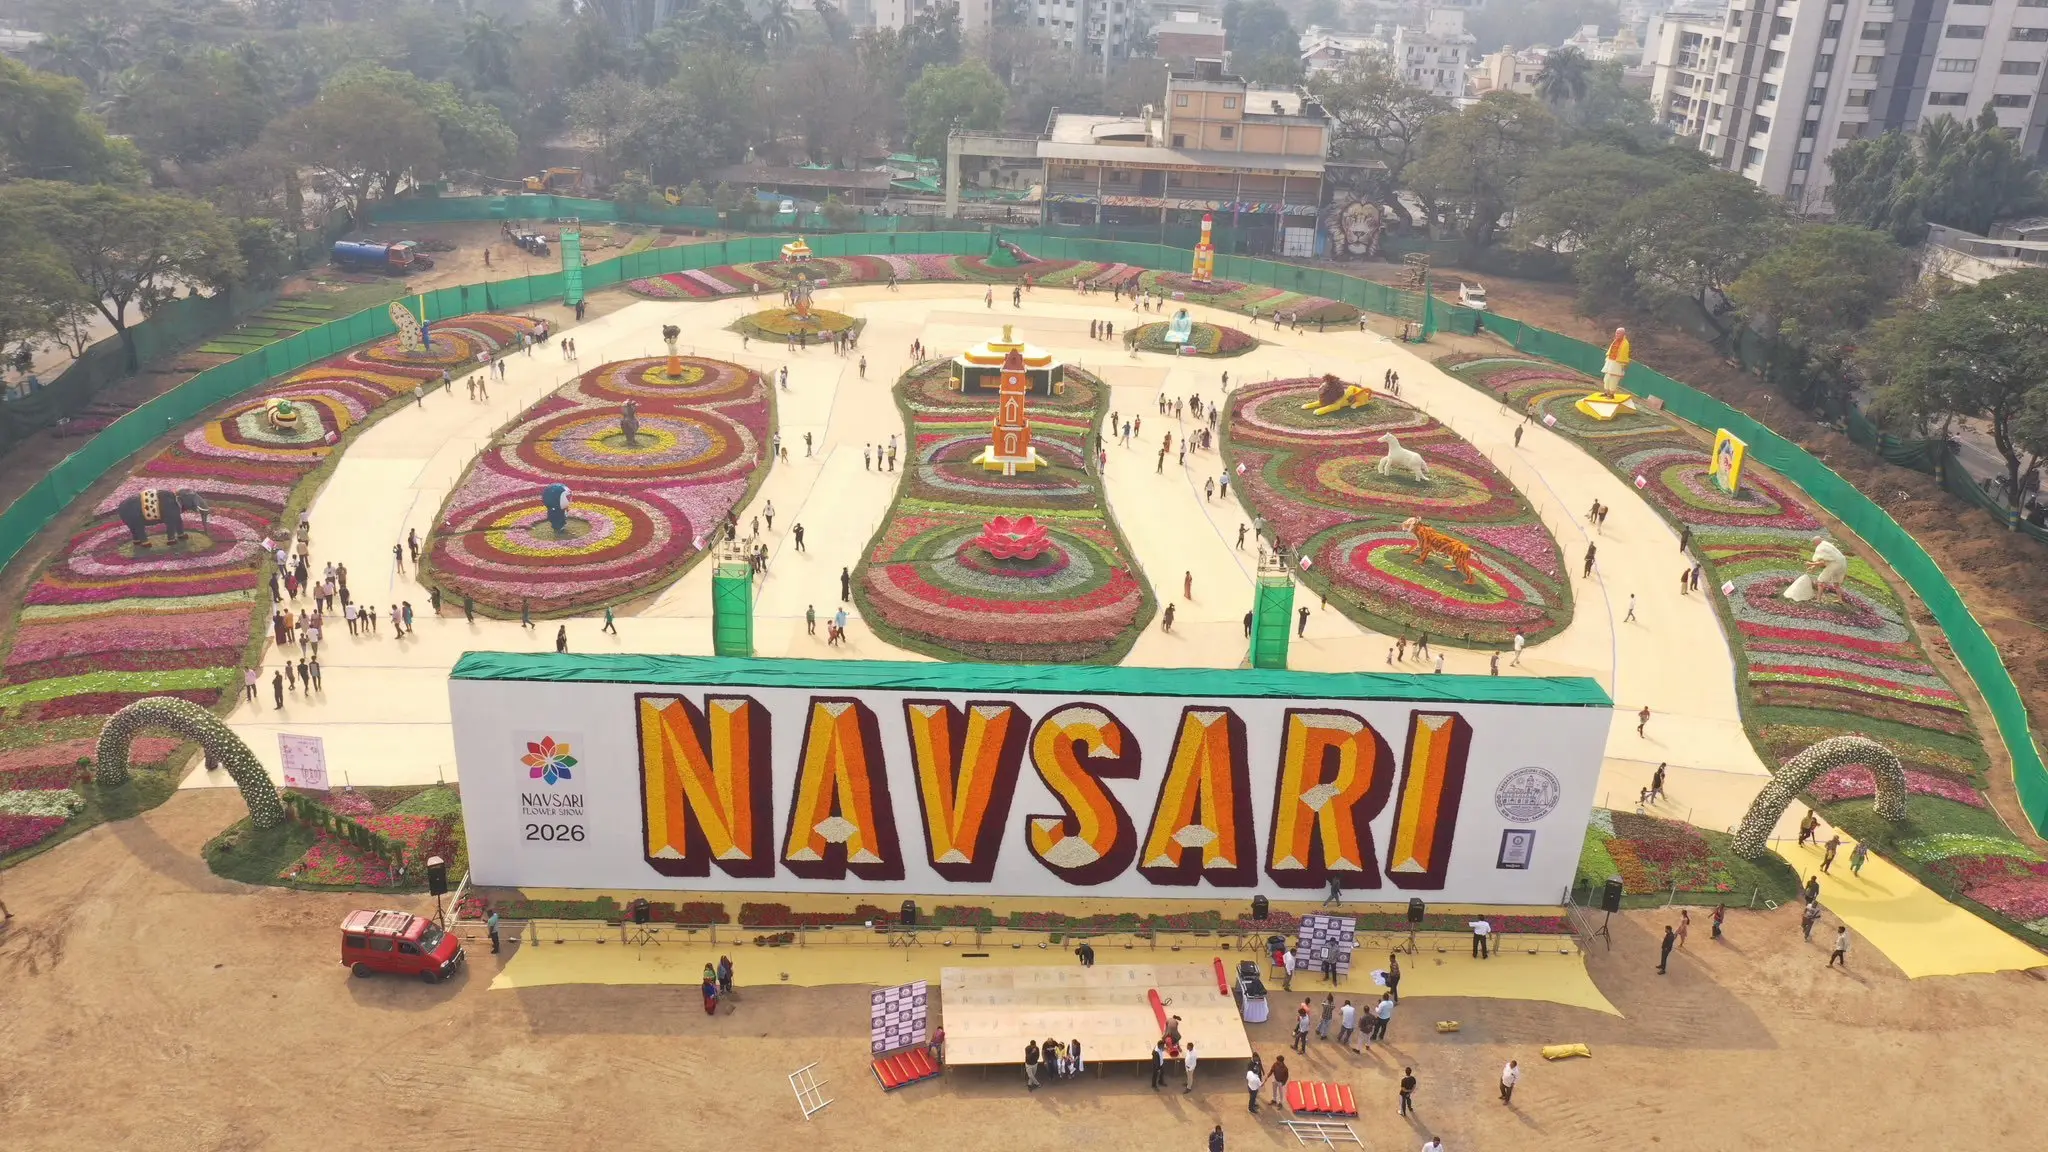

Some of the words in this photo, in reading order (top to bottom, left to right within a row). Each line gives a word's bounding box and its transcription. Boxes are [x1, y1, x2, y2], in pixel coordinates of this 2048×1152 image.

[634, 692, 1472, 890] NAVSARI
[522, 793, 583, 807] NAVSARI
[522, 807, 556, 816] FLOWER
[558, 808, 584, 816] SHOW
[526, 824, 585, 841] 2026
